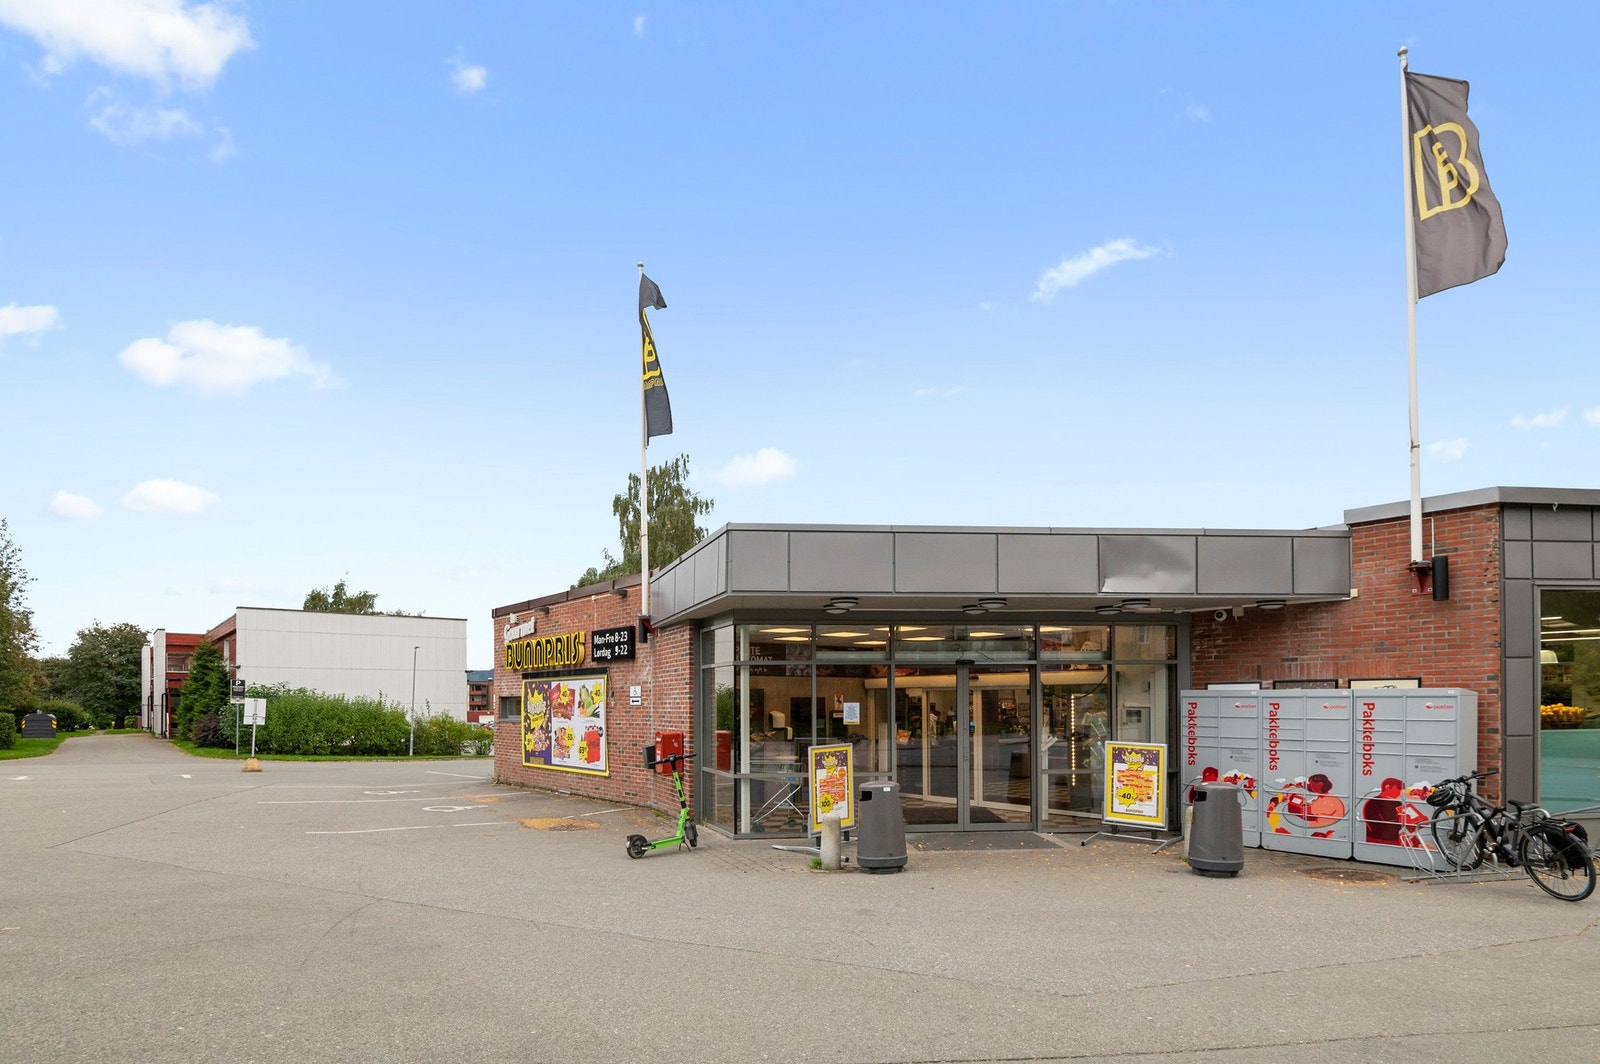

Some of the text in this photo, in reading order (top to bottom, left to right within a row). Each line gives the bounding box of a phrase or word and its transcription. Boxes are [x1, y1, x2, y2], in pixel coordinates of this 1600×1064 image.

[505, 632, 586, 669] BUNNPRIS
[593, 644, 628, 659] Lørdag 9-22
[594, 631, 628, 644] Man-Fre 8-23
[1187, 701, 1198, 766] Pakkeboks
[1268, 702, 1280, 771] Pakkeboks
[1362, 702, 1376, 776] Pakkeboks
